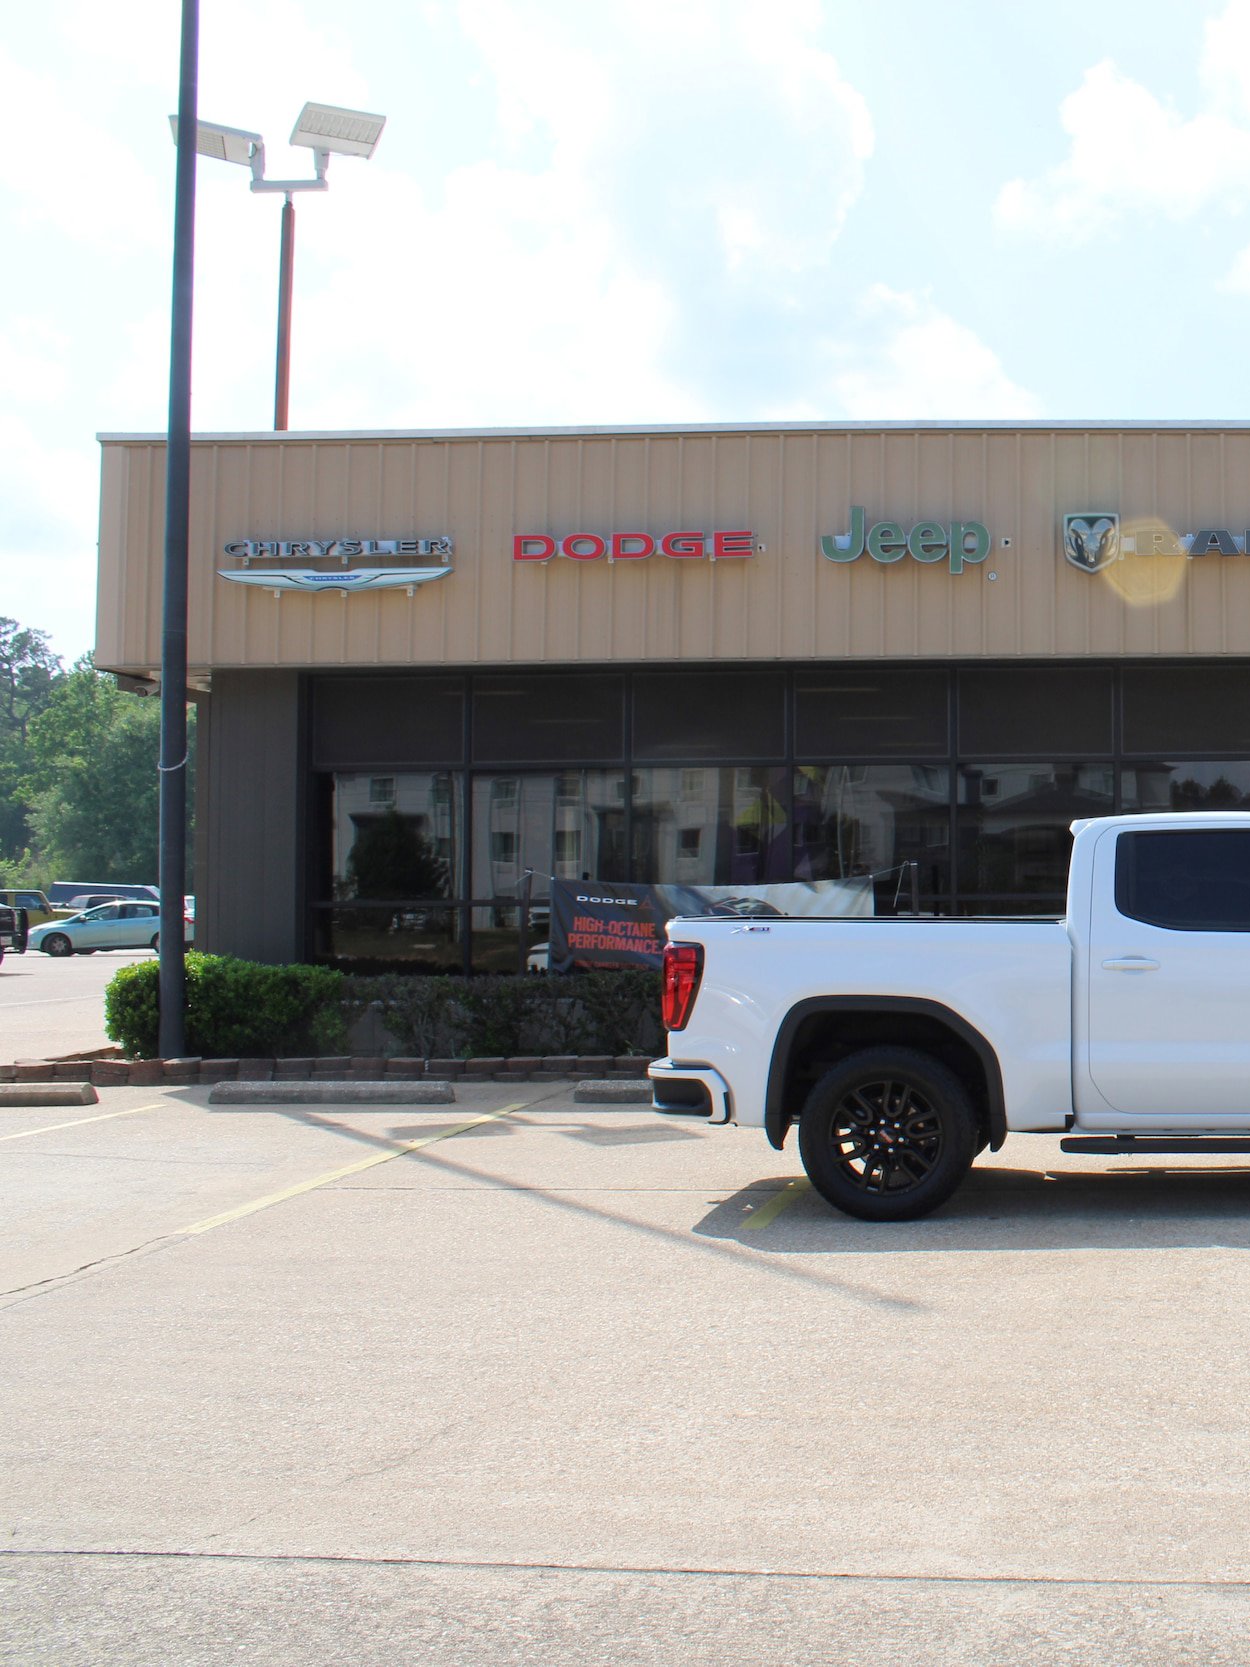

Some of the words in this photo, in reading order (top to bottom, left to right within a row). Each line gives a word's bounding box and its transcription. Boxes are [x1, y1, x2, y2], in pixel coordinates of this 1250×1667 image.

[224, 538, 452, 558] CHRYSLER
[512, 531, 753, 562] DODGE
[821, 505, 991, 575] Jeep
[576, 895, 638, 906] DODGE
[573, 916, 656, 938] HIGH-OCTANE
